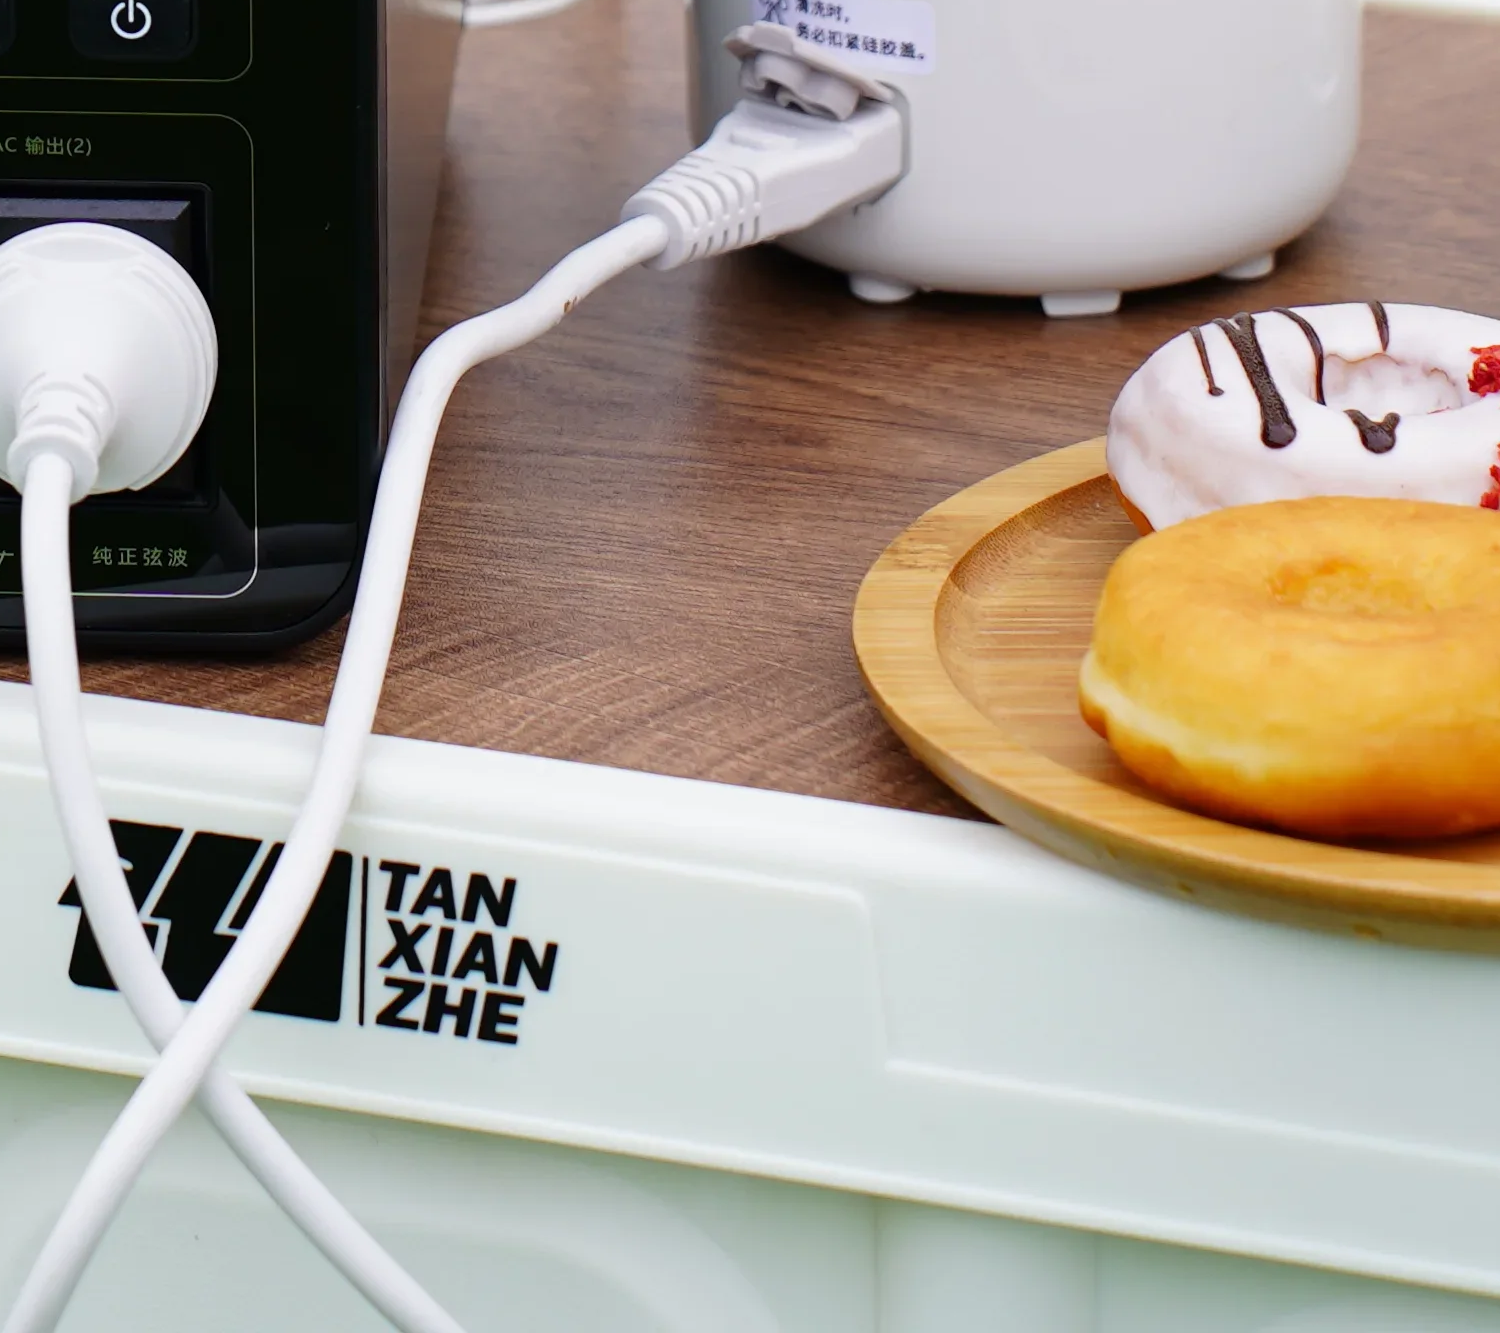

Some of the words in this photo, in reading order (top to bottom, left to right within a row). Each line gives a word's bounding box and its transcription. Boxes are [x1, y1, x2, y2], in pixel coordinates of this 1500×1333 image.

[93, 546, 187, 567] 纯正弦波
[379, 859, 517, 927] TAN
[378, 918, 558, 991] XIAN
[376, 976, 525, 1045] ZHE
